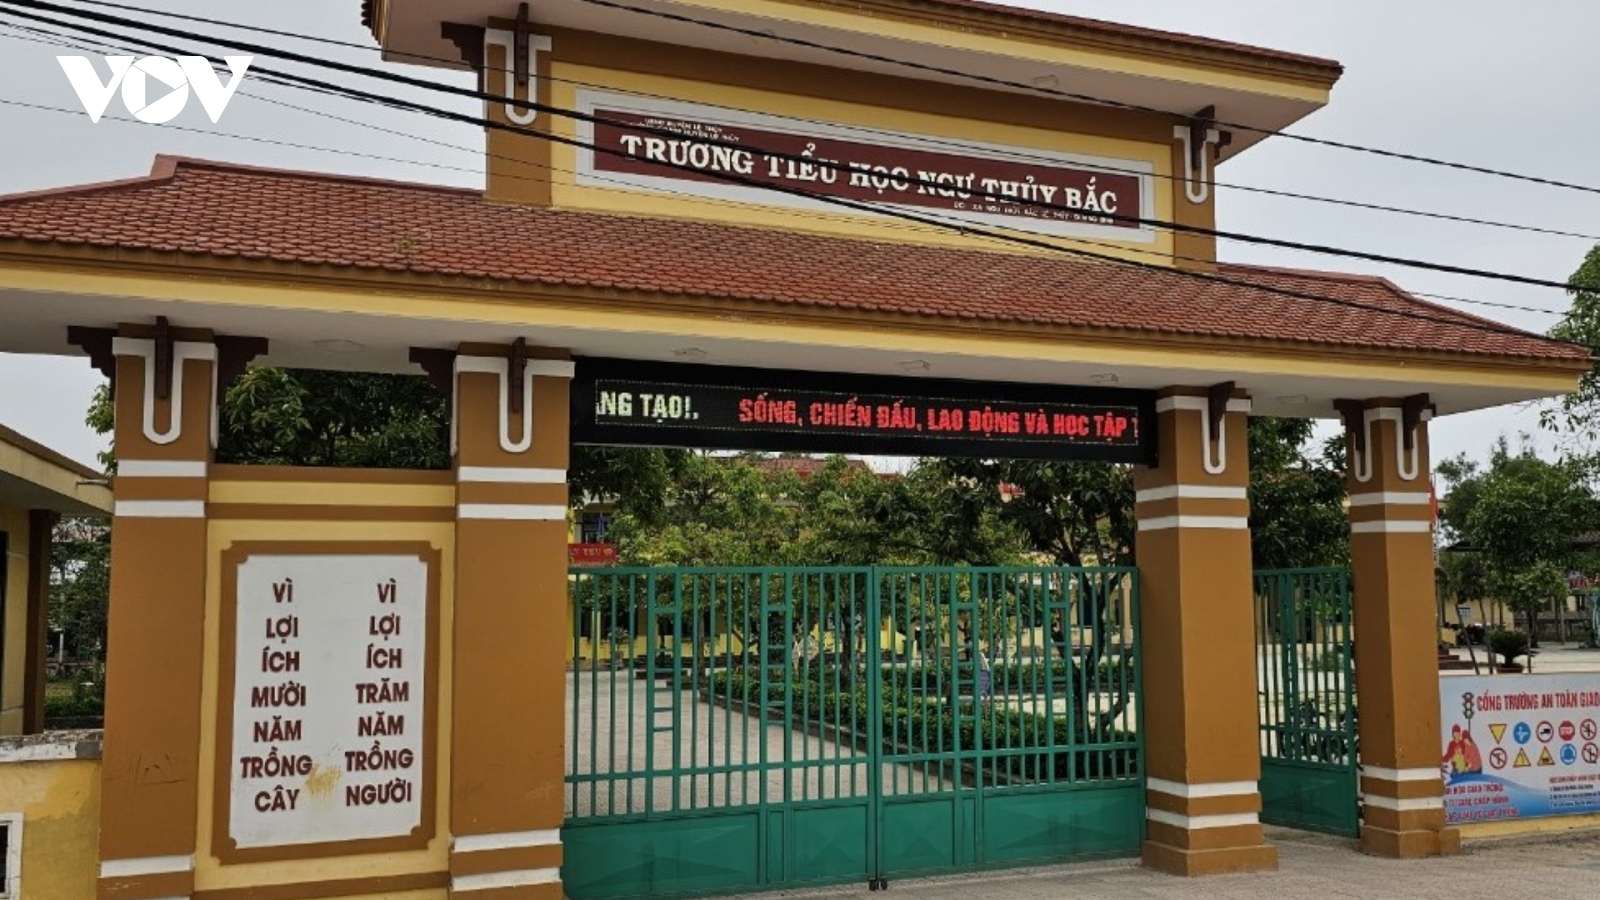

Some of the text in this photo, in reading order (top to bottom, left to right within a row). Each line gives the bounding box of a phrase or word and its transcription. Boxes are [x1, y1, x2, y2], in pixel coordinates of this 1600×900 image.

[849, 161, 909, 195] HỌC
[917, 170, 975, 198] NGƯ
[1065, 176, 1117, 214] BẮC
[739, 392, 803, 426] SỐNG,
[809, 397, 872, 427] CHIẾN
[877, 400, 923, 431] ĐẤU,
[928, 408, 963, 431] LAO
[969, 406, 1020, 437] ĐỘNG
[1025, 409, 1049, 434] VÀ
[1053, 414, 1089, 440] HỌC
[1094, 412, 1127, 441] TẬP
[273, 578, 293, 603] VÌ
[377, 578, 397, 603] VÌ
[266, 614, 299, 643] LỢI
[369, 613, 401, 641] LỢI
[262, 645, 300, 673] ÍCH
[366, 643, 402, 669] ÍCH
[251, 680, 306, 708] MƯỜI
[356, 677, 410, 704] TRĂM
[1541, 694, 1553, 709] AN
[1555, 689, 1578, 708] TOÀN
[253, 715, 302, 742] NĂM
[358, 711, 404, 737] NĂM
[240, 746, 313, 779] TRỒNG
[345, 740, 414, 772] TRỒNG
[254, 784, 300, 813] CÂY
[345, 777, 412, 807] NGƯỜI
